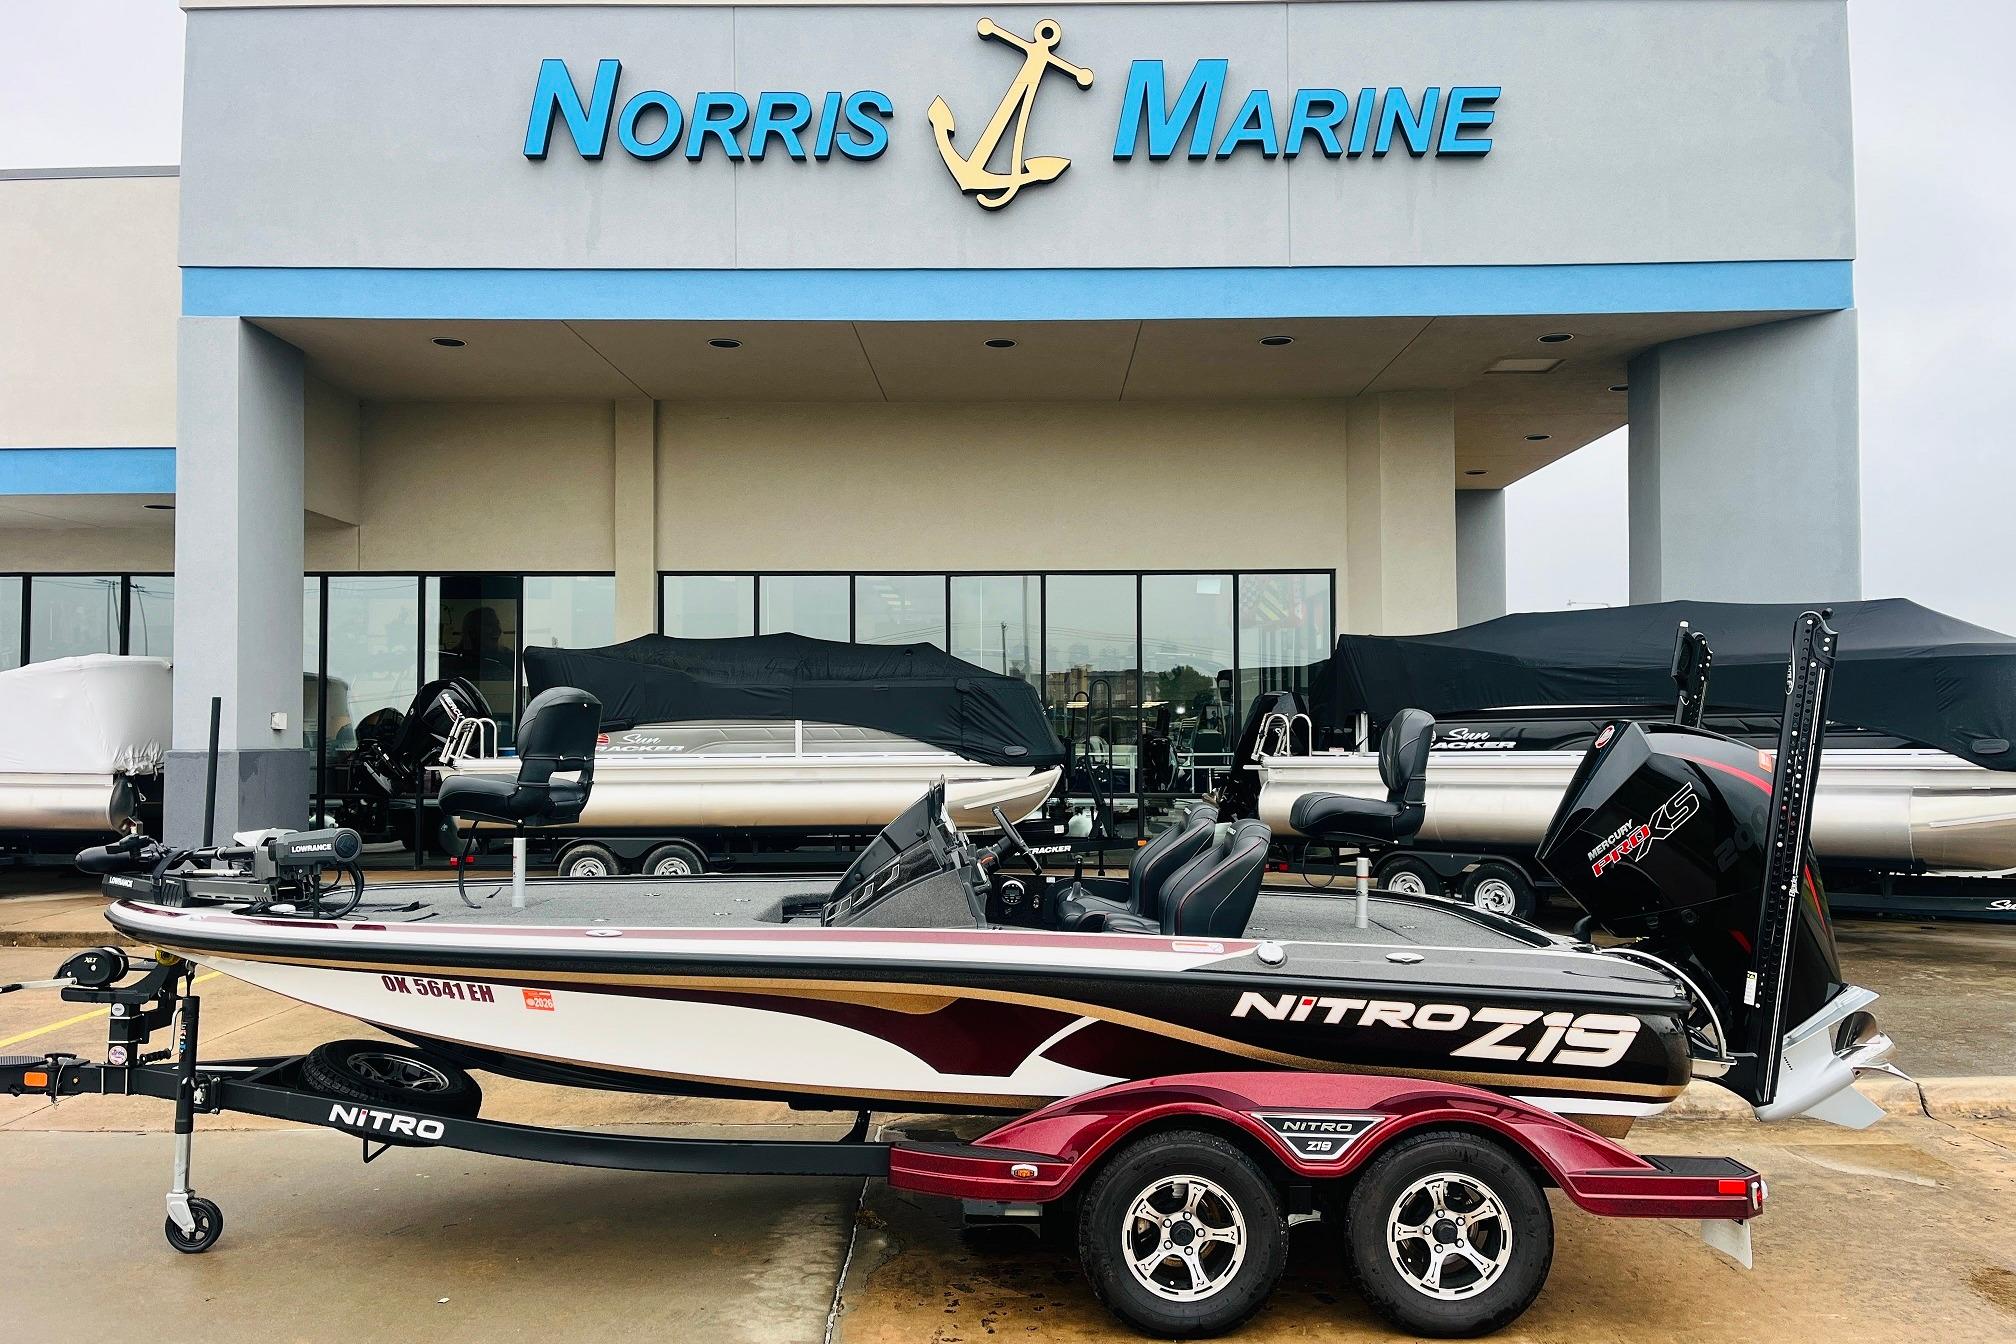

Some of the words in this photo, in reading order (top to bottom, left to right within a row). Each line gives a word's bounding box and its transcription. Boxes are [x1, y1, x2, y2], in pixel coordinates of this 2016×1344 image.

[523, 59, 894, 161] NORRIS
[1112, 59, 1502, 160] MARINE
[617, 733, 662, 745] Sun
[1443, 727, 1491, 741] Sun
[1591, 823, 1651, 878] PRO
[1634, 781, 1700, 863] XS
[1587, 818, 1634, 862] MERCURY
[291, 843, 332, 853] LOWRANCE
[108, 876, 134, 888] LOWRANCE
[381, 975, 412, 995] OK
[412, 978, 465, 1001] 5641
[466, 984, 495, 1003] EH
[534, 997, 553, 1009] 2026
[1449, 1006, 1642, 1068] Z19
[1282, 1121, 1353, 1132] NITRO
[1305, 1140, 1332, 1151] Z19
